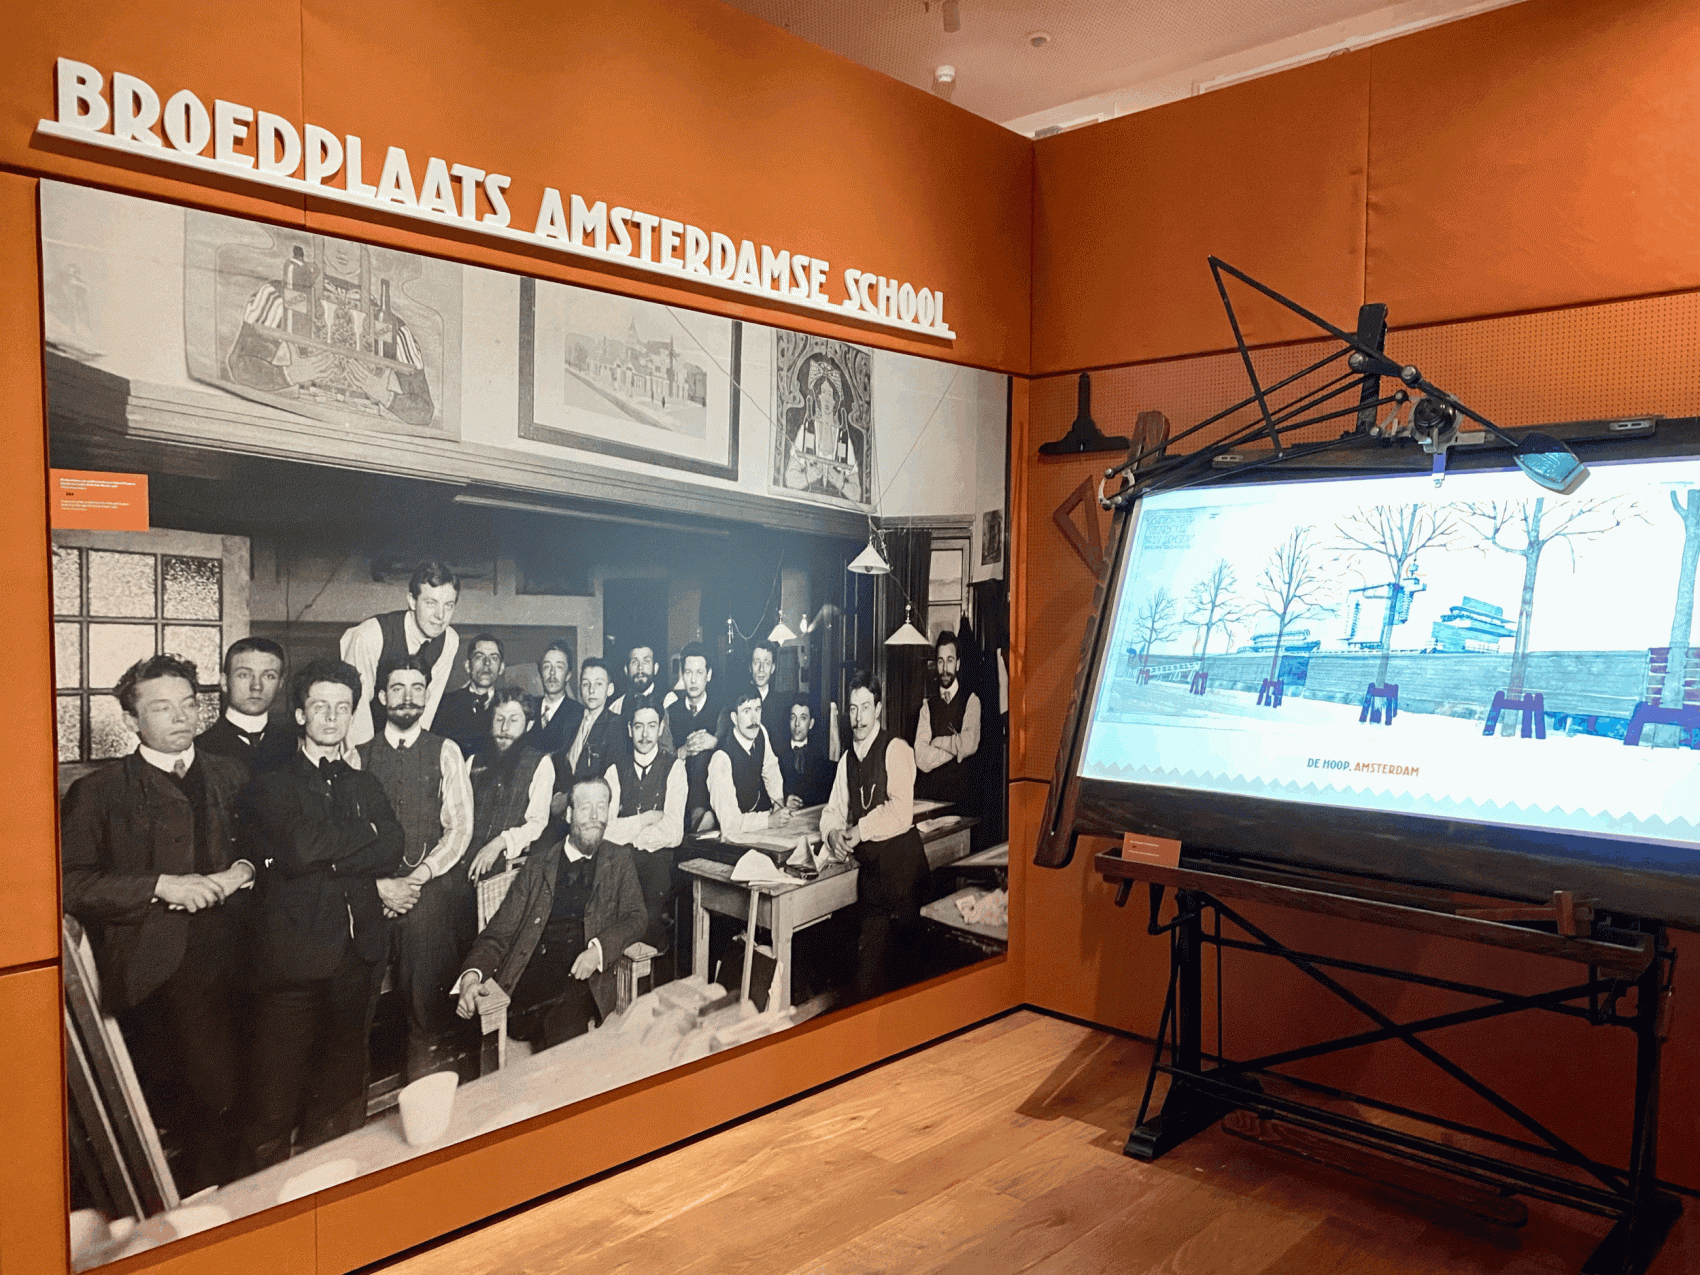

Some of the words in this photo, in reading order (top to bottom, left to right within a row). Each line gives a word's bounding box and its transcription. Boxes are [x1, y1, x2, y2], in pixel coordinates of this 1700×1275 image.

[56, 56, 511, 228] BROEDPLAATS
[535, 187, 829, 304] AMSTERDAMSE
[843, 268, 950, 331] SCHOOL
[1307, 758, 1320, 768] DE
[1354, 762, 1419, 776] AMSTERDAM
